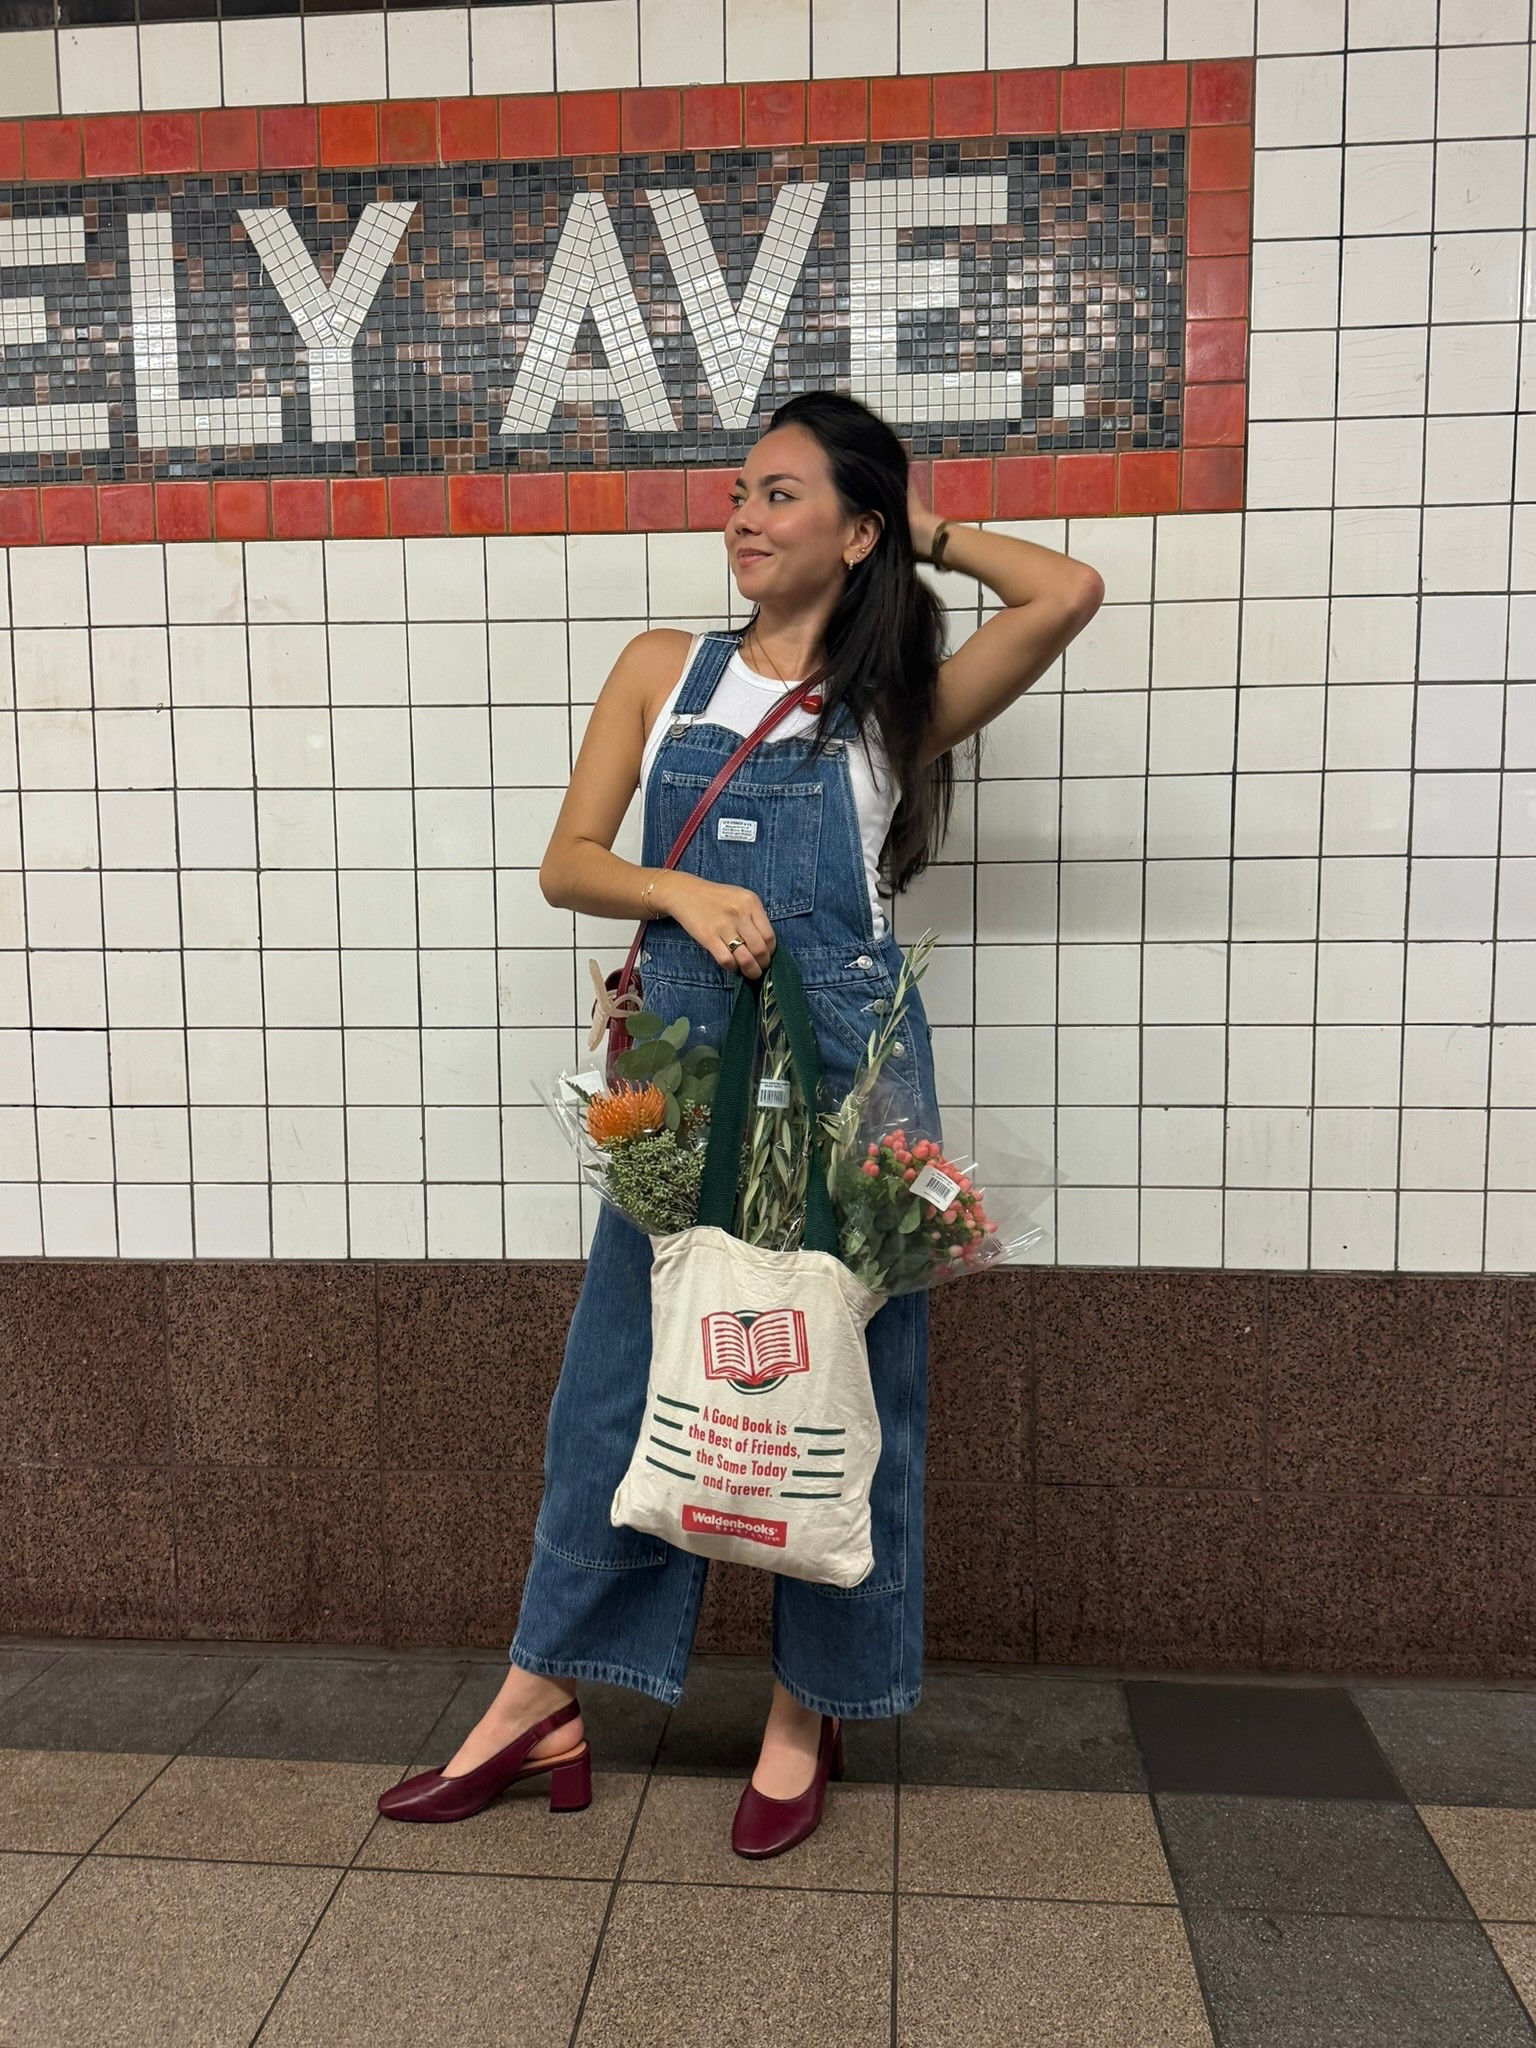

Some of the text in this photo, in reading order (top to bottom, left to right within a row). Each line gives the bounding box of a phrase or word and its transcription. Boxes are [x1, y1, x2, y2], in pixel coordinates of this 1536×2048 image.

[499, 175, 1084, 434] AVE.
[702, 1406, 788, 1436] A Good Book is
[688, 1424, 801, 1460] the Best of Friends,
[696, 1448, 788, 1482] the Same Today
[703, 1475, 773, 1498] and Forever.
